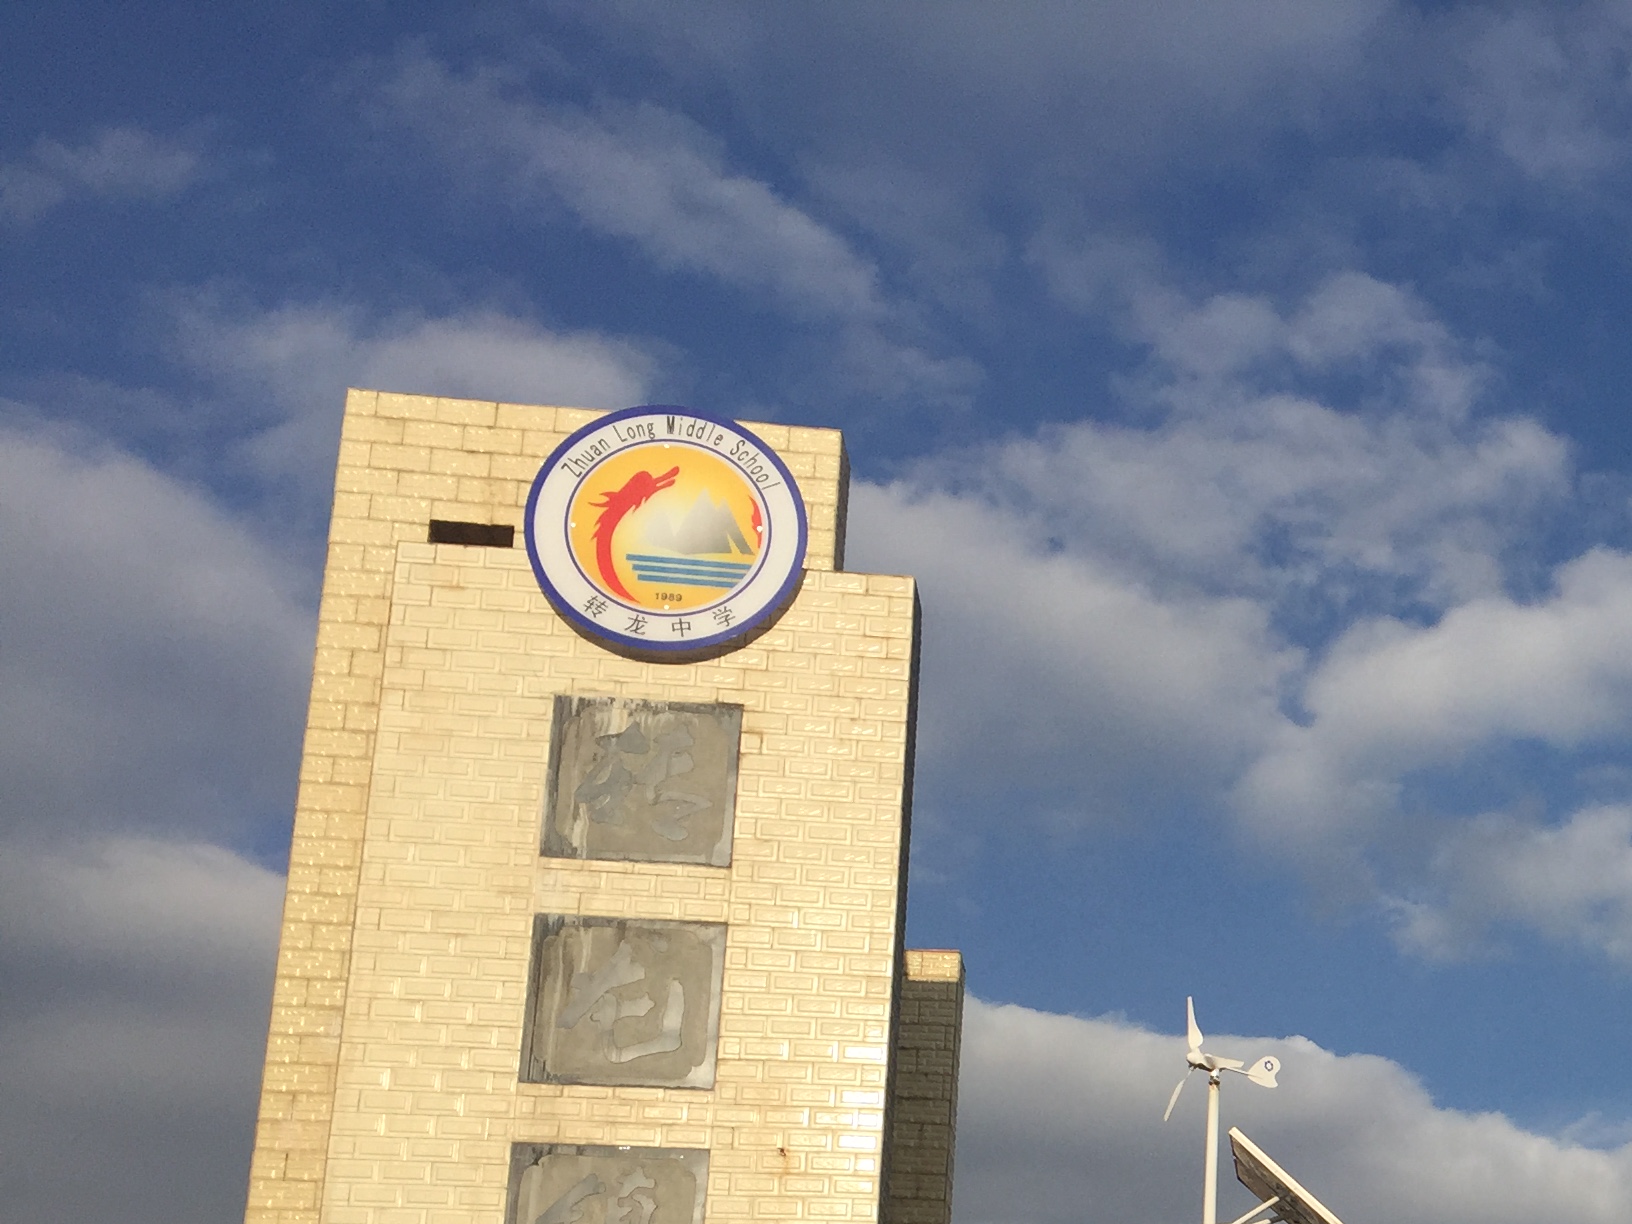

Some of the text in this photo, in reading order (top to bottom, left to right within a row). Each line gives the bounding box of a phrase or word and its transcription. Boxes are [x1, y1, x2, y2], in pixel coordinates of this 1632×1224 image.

[561, 415, 781, 490] Zhuan Long Middle School
[583, 595, 736, 638] 转龙中学
[655, 592, 683, 602] 1989
